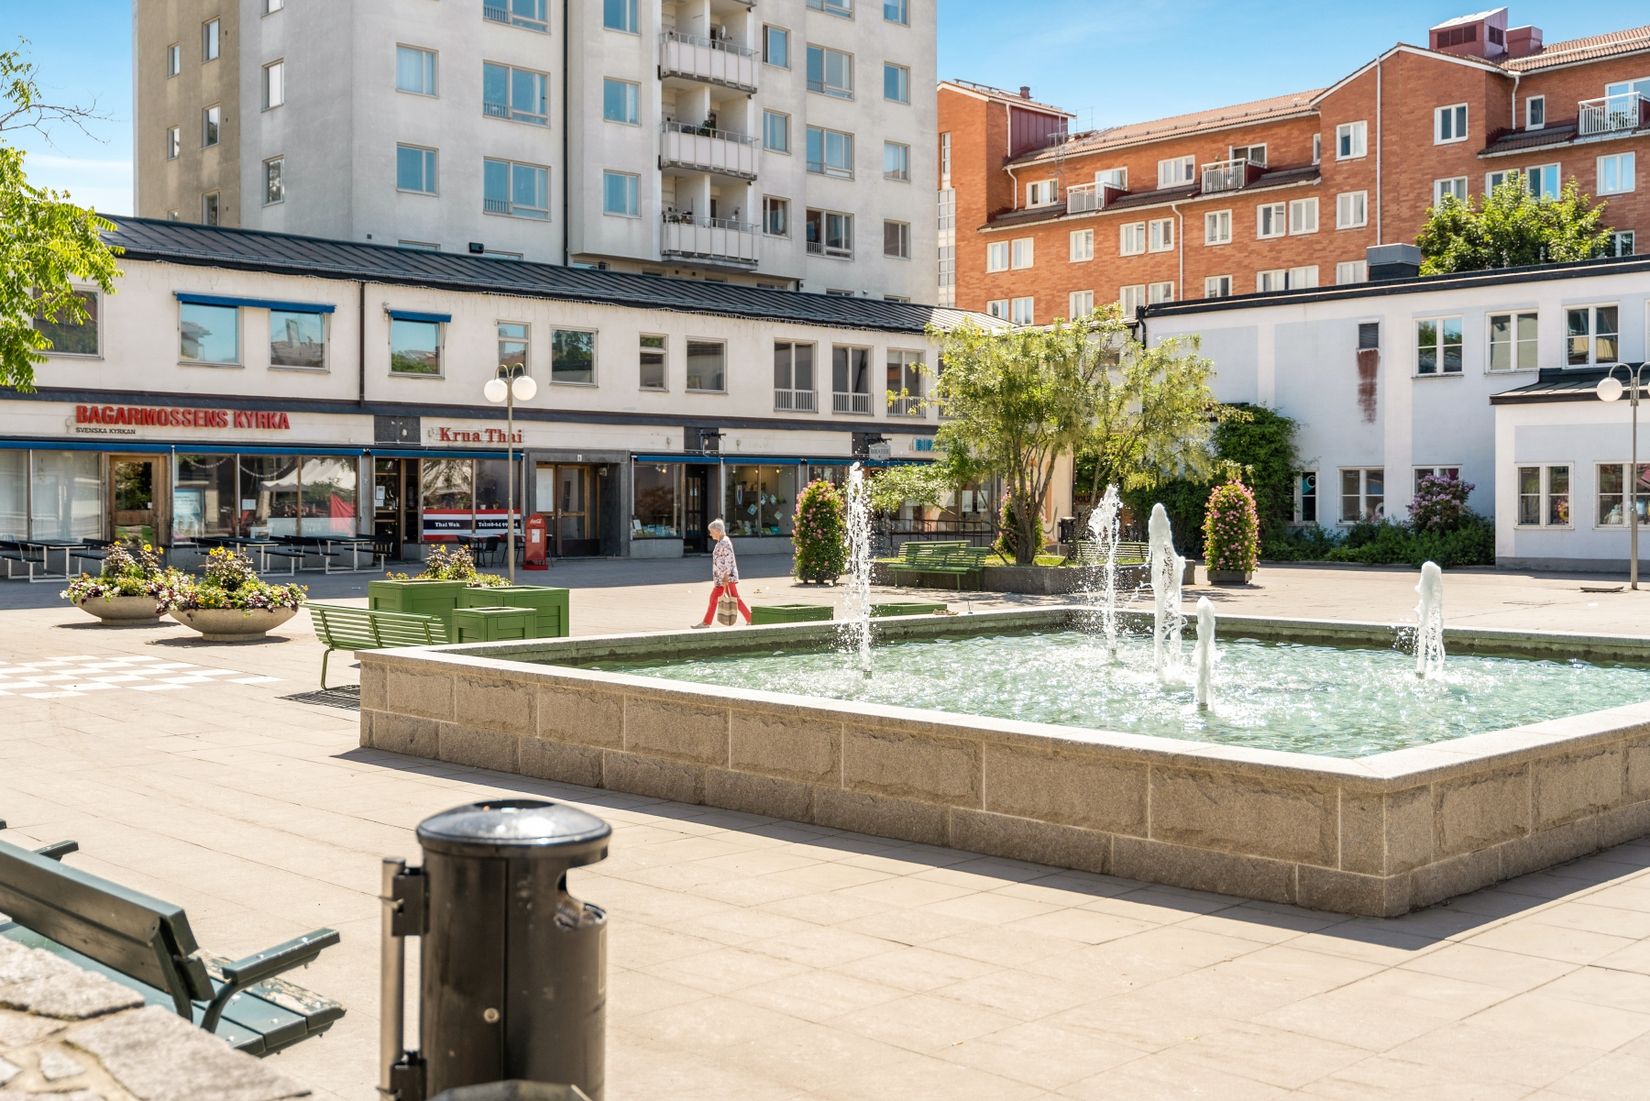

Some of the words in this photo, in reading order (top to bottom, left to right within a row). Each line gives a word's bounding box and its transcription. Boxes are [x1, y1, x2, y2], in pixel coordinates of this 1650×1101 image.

[75, 405, 228, 428] BAGARMOSSENS
[233, 411, 290, 430] KYRKA
[439, 427, 481, 442] Krua
